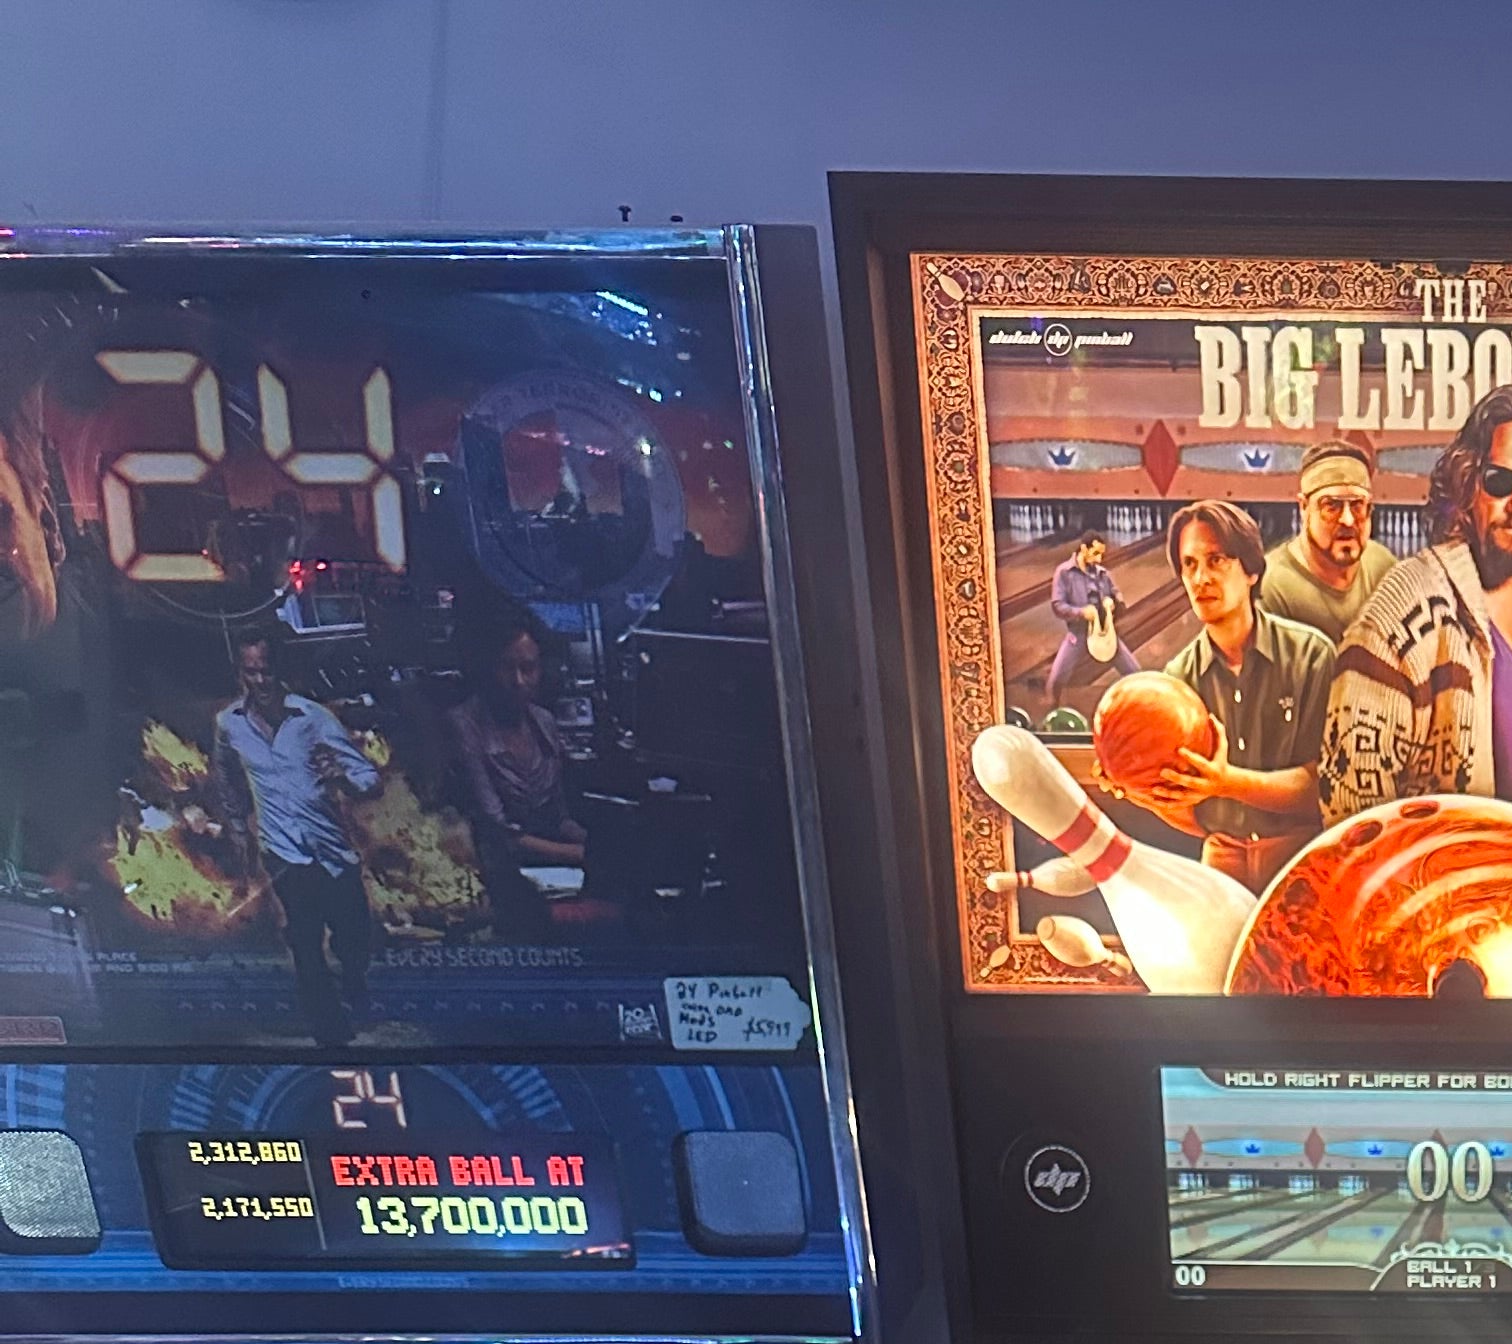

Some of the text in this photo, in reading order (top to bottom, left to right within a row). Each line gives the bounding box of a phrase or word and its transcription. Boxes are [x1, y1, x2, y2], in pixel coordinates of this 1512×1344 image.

[1417, 278, 1488, 323] THE
[989, 331, 1042, 345] dutch
[1074, 331, 1133, 348] pinball
[1194, 325, 1320, 429] BIG
[95, 350, 408, 583] 24
[1225, 1072, 1277, 1086] HOLD
[1284, 1073, 1341, 1087] RIGHT
[1348, 1073, 1430, 1088] FLIPPER
[1437, 1074, 1476, 1089] FOR
[331, 1070, 407, 1128] 24
[188, 1141, 303, 1165] 2,312,860
[331, 1154, 585, 1187] EXTRA BALL AT
[1407, 1140, 1494, 1202] 00
[202, 1196, 314, 1220] 2,171,550
[356, 1196, 588, 1238] 13,700,000
[1175, 1266, 1206, 1286] 00
[1407, 1260, 1458, 1274] BALL
[1407, 1276, 1482, 1289] PLAYER
